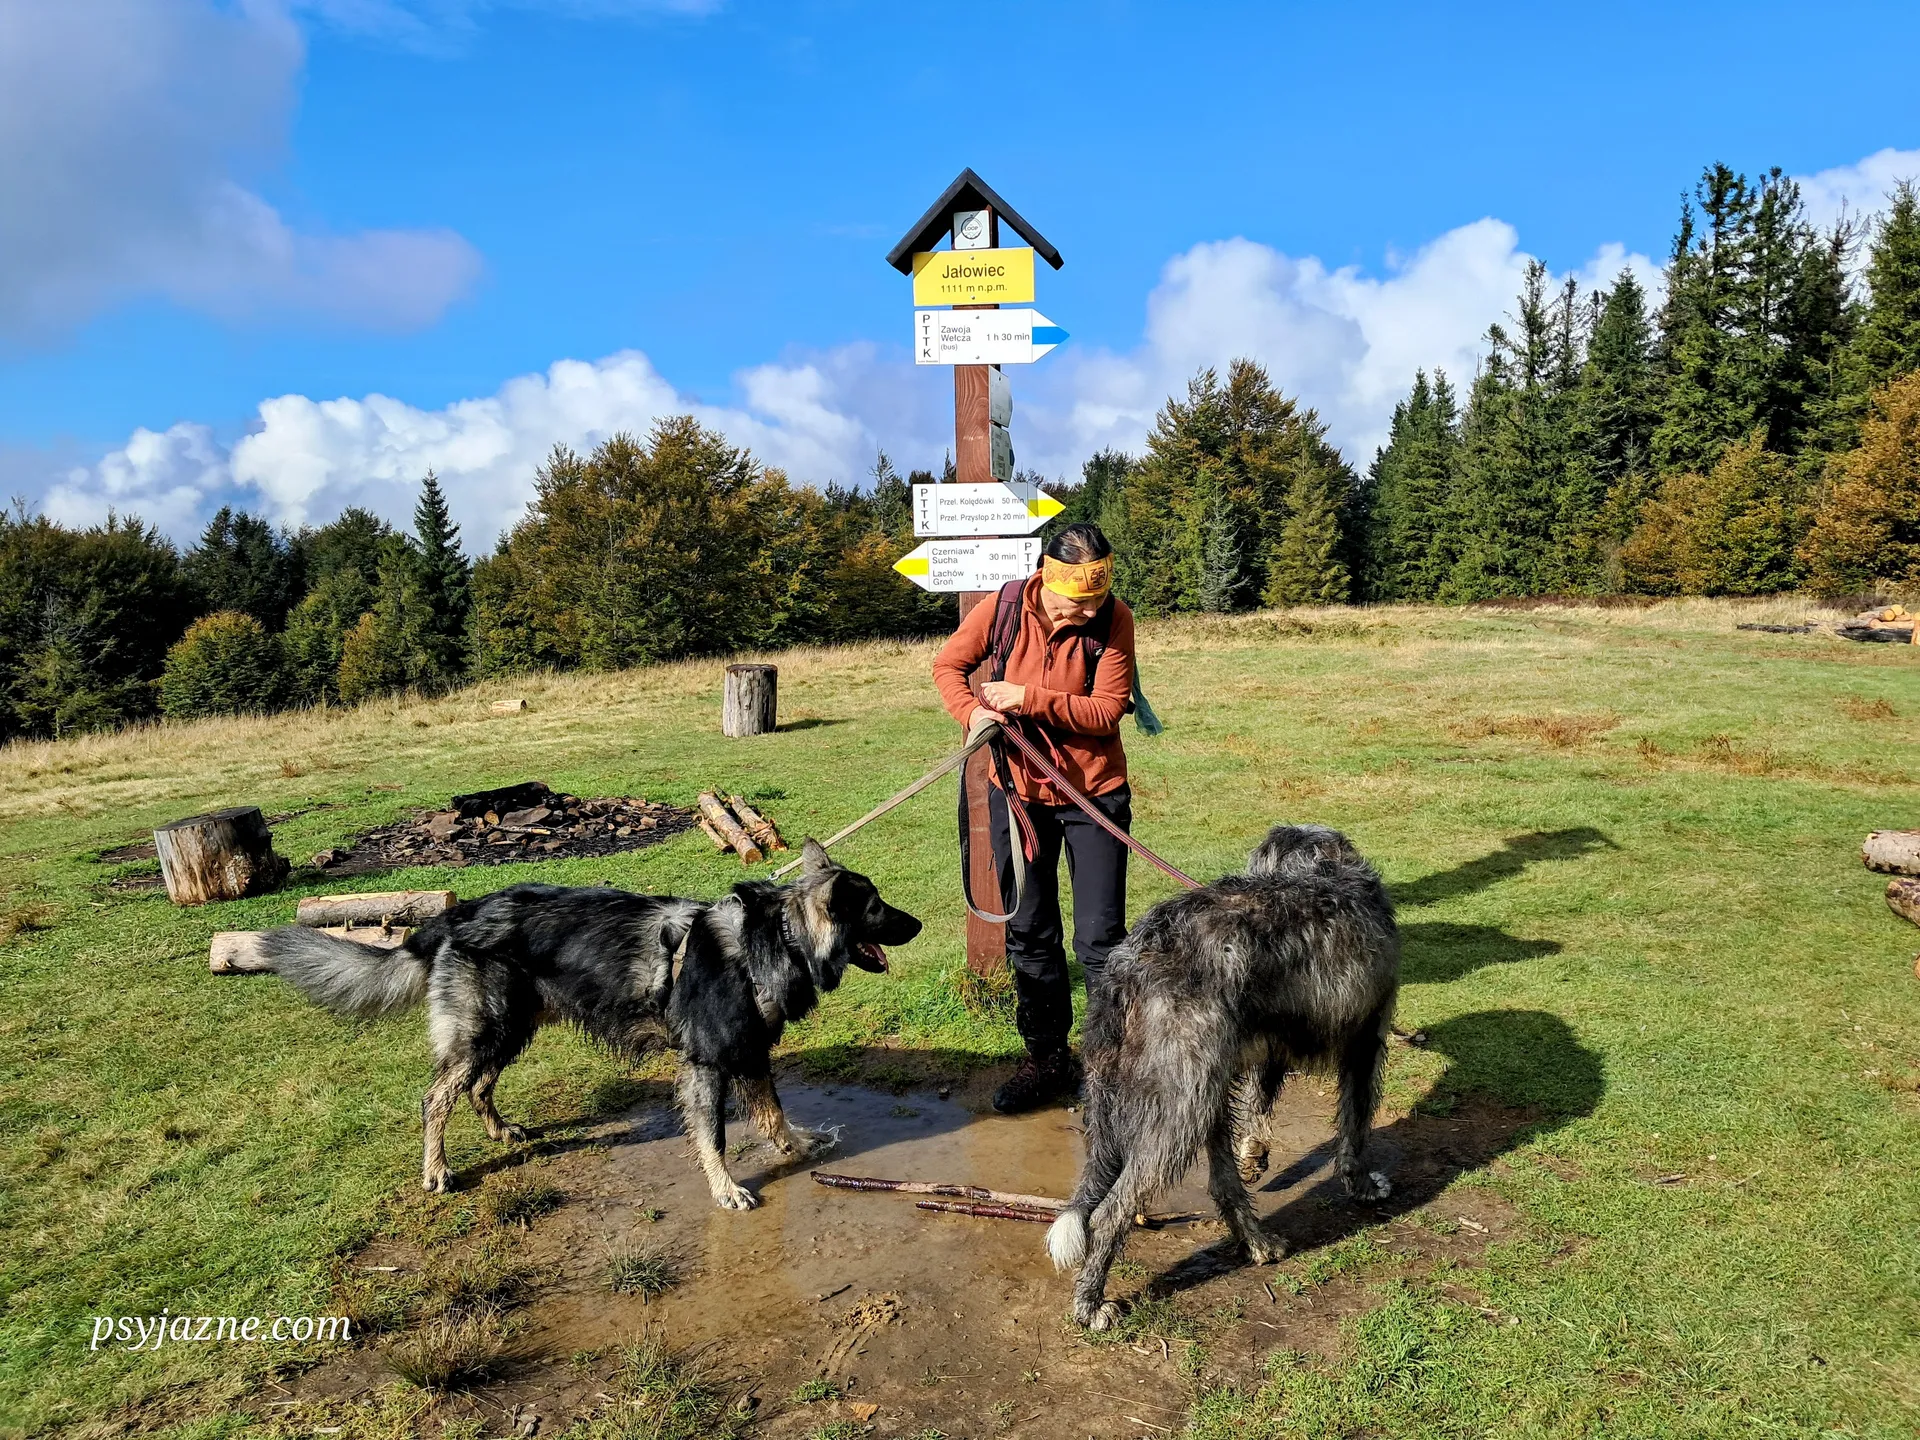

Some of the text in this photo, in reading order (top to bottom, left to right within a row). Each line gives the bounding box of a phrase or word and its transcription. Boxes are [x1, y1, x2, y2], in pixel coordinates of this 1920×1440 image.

[942, 263, 1005, 279] Jałowiec
[941, 284, 963, 293] 1111
[977, 284, 1008, 293] n.p.m.
[940, 325, 971, 335] Zawoja
[986, 332, 1030, 341] 1 h 30 min
[940, 343, 958, 351] (bus)
[1001, 497, 1025, 505] 50 min
[990, 513, 996, 521] 2
[996, 513, 1002, 521] h
[1003, 513, 1012, 521] 20
[1013, 512, 1026, 520] min
[931, 548, 975, 556] Czerniawa
[989, 552, 1017, 561] 30 min
[932, 556, 958, 565] Sucha
[975, 572, 1017, 581] 1 h 30 min
